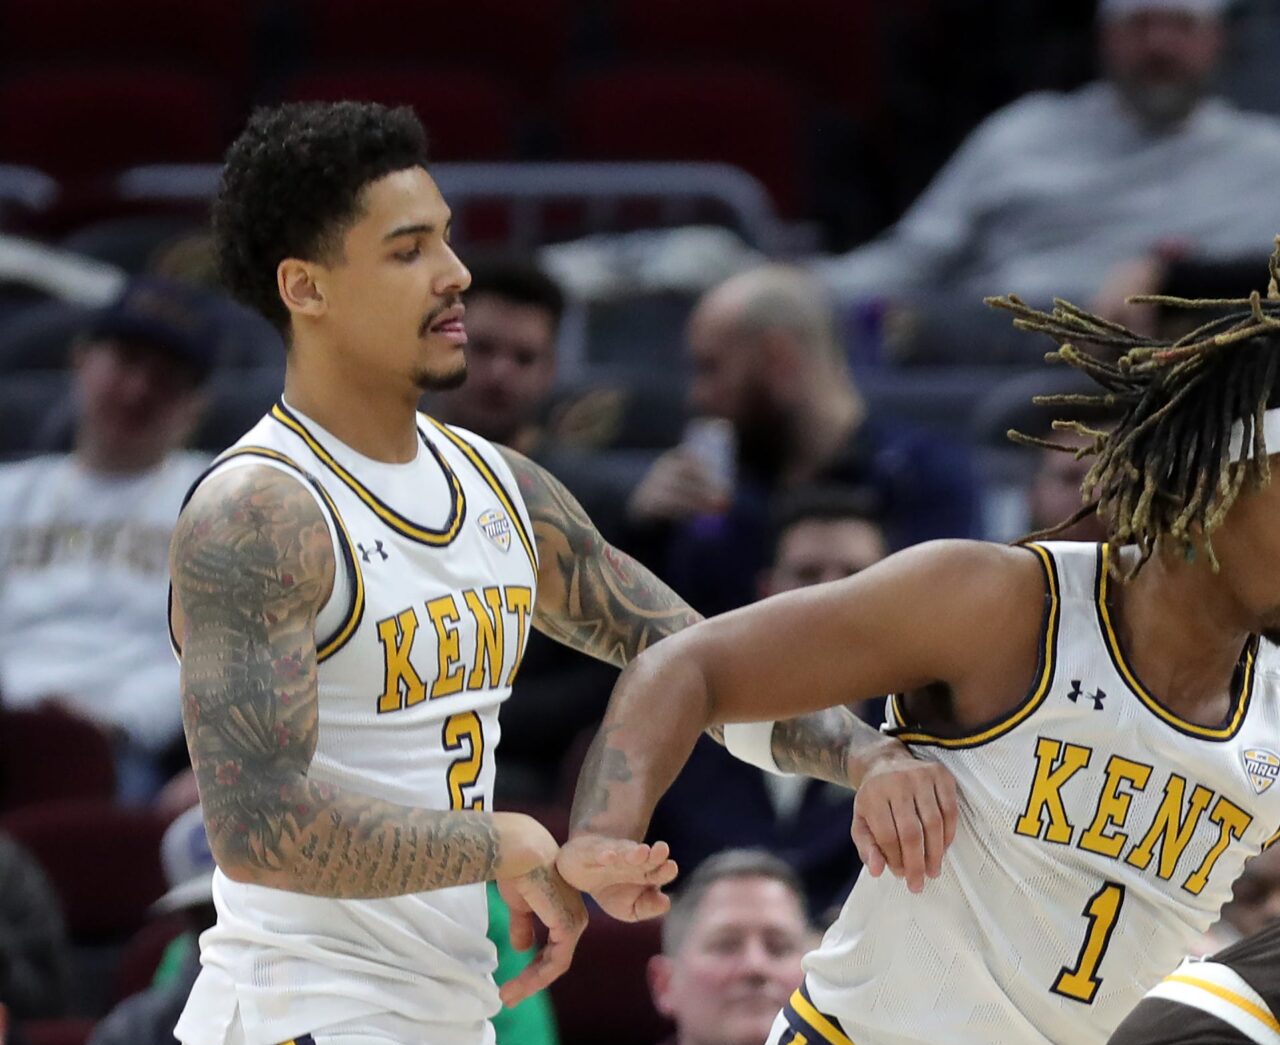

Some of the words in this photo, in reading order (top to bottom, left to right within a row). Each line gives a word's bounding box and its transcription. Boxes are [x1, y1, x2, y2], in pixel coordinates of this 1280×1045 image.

[376, 586, 532, 714] KENT
[441, 710, 485, 812] 2
[1014, 736, 1254, 896] KENT
[1246, 759, 1280, 779] MAC
[1049, 880, 1126, 1005] 1
